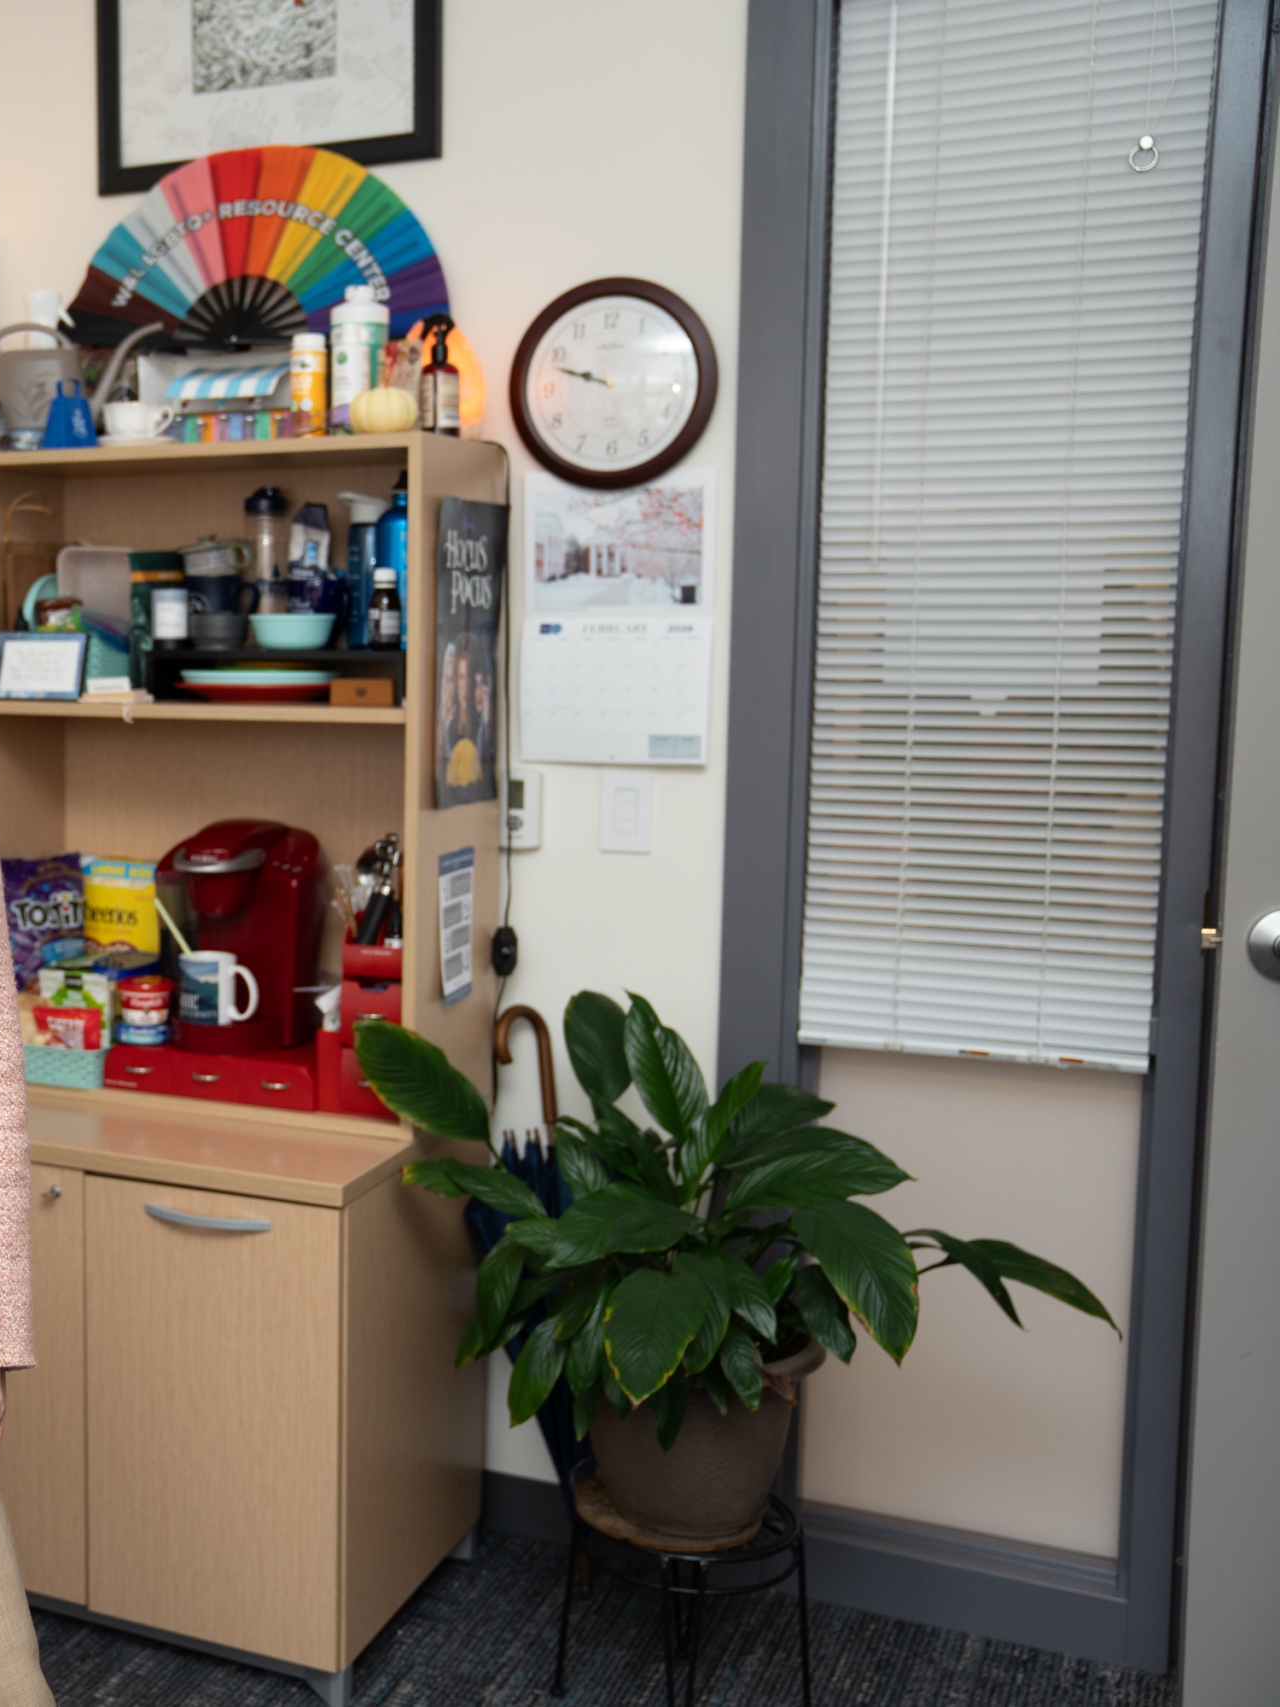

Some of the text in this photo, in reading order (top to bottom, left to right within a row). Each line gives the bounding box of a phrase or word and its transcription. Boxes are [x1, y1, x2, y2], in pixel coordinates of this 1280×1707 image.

[110, 267, 147, 307] W&L
[218, 199, 337, 236] RESOURCE
[335, 228, 391, 301] CENTER
[603, 312, 620, 328] 12
[552, 347, 566, 364] 10
[543, 382, 556, 399] 9
[551, 412, 562, 429] 8
[636, 428, 650, 447] 5
[606, 439, 619, 457] 6
